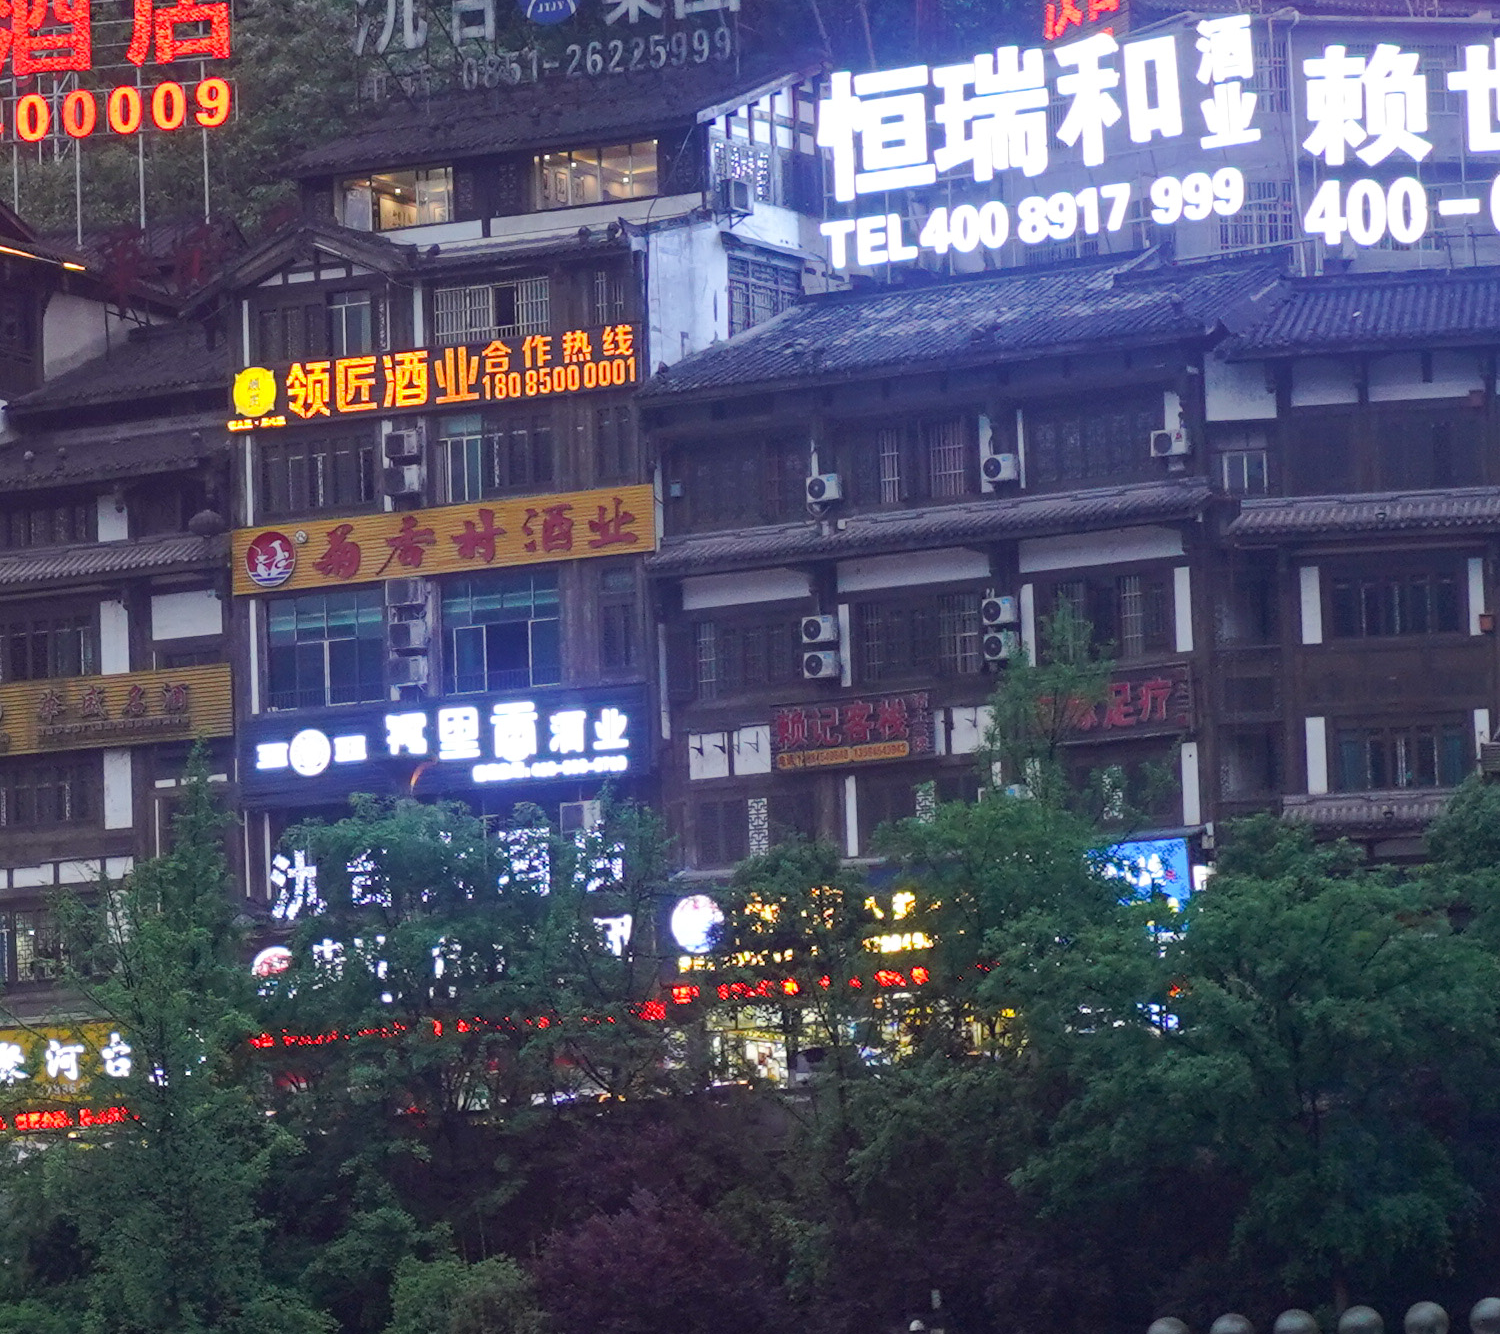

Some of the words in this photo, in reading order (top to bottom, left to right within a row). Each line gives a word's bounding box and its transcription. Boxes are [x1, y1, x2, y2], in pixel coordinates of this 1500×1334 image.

[815, 30, 1184, 203] 恒瑞和
[1195, 12, 1263, 150] 酒业
[1016, 180, 1132, 243] 8917
[1149, 166, 1245, 226] 999
[285, 345, 481, 420] 领匠酒业
[481, 323, 635, 374] 合作热线
[775, 698, 910, 752] 赖记客栈
